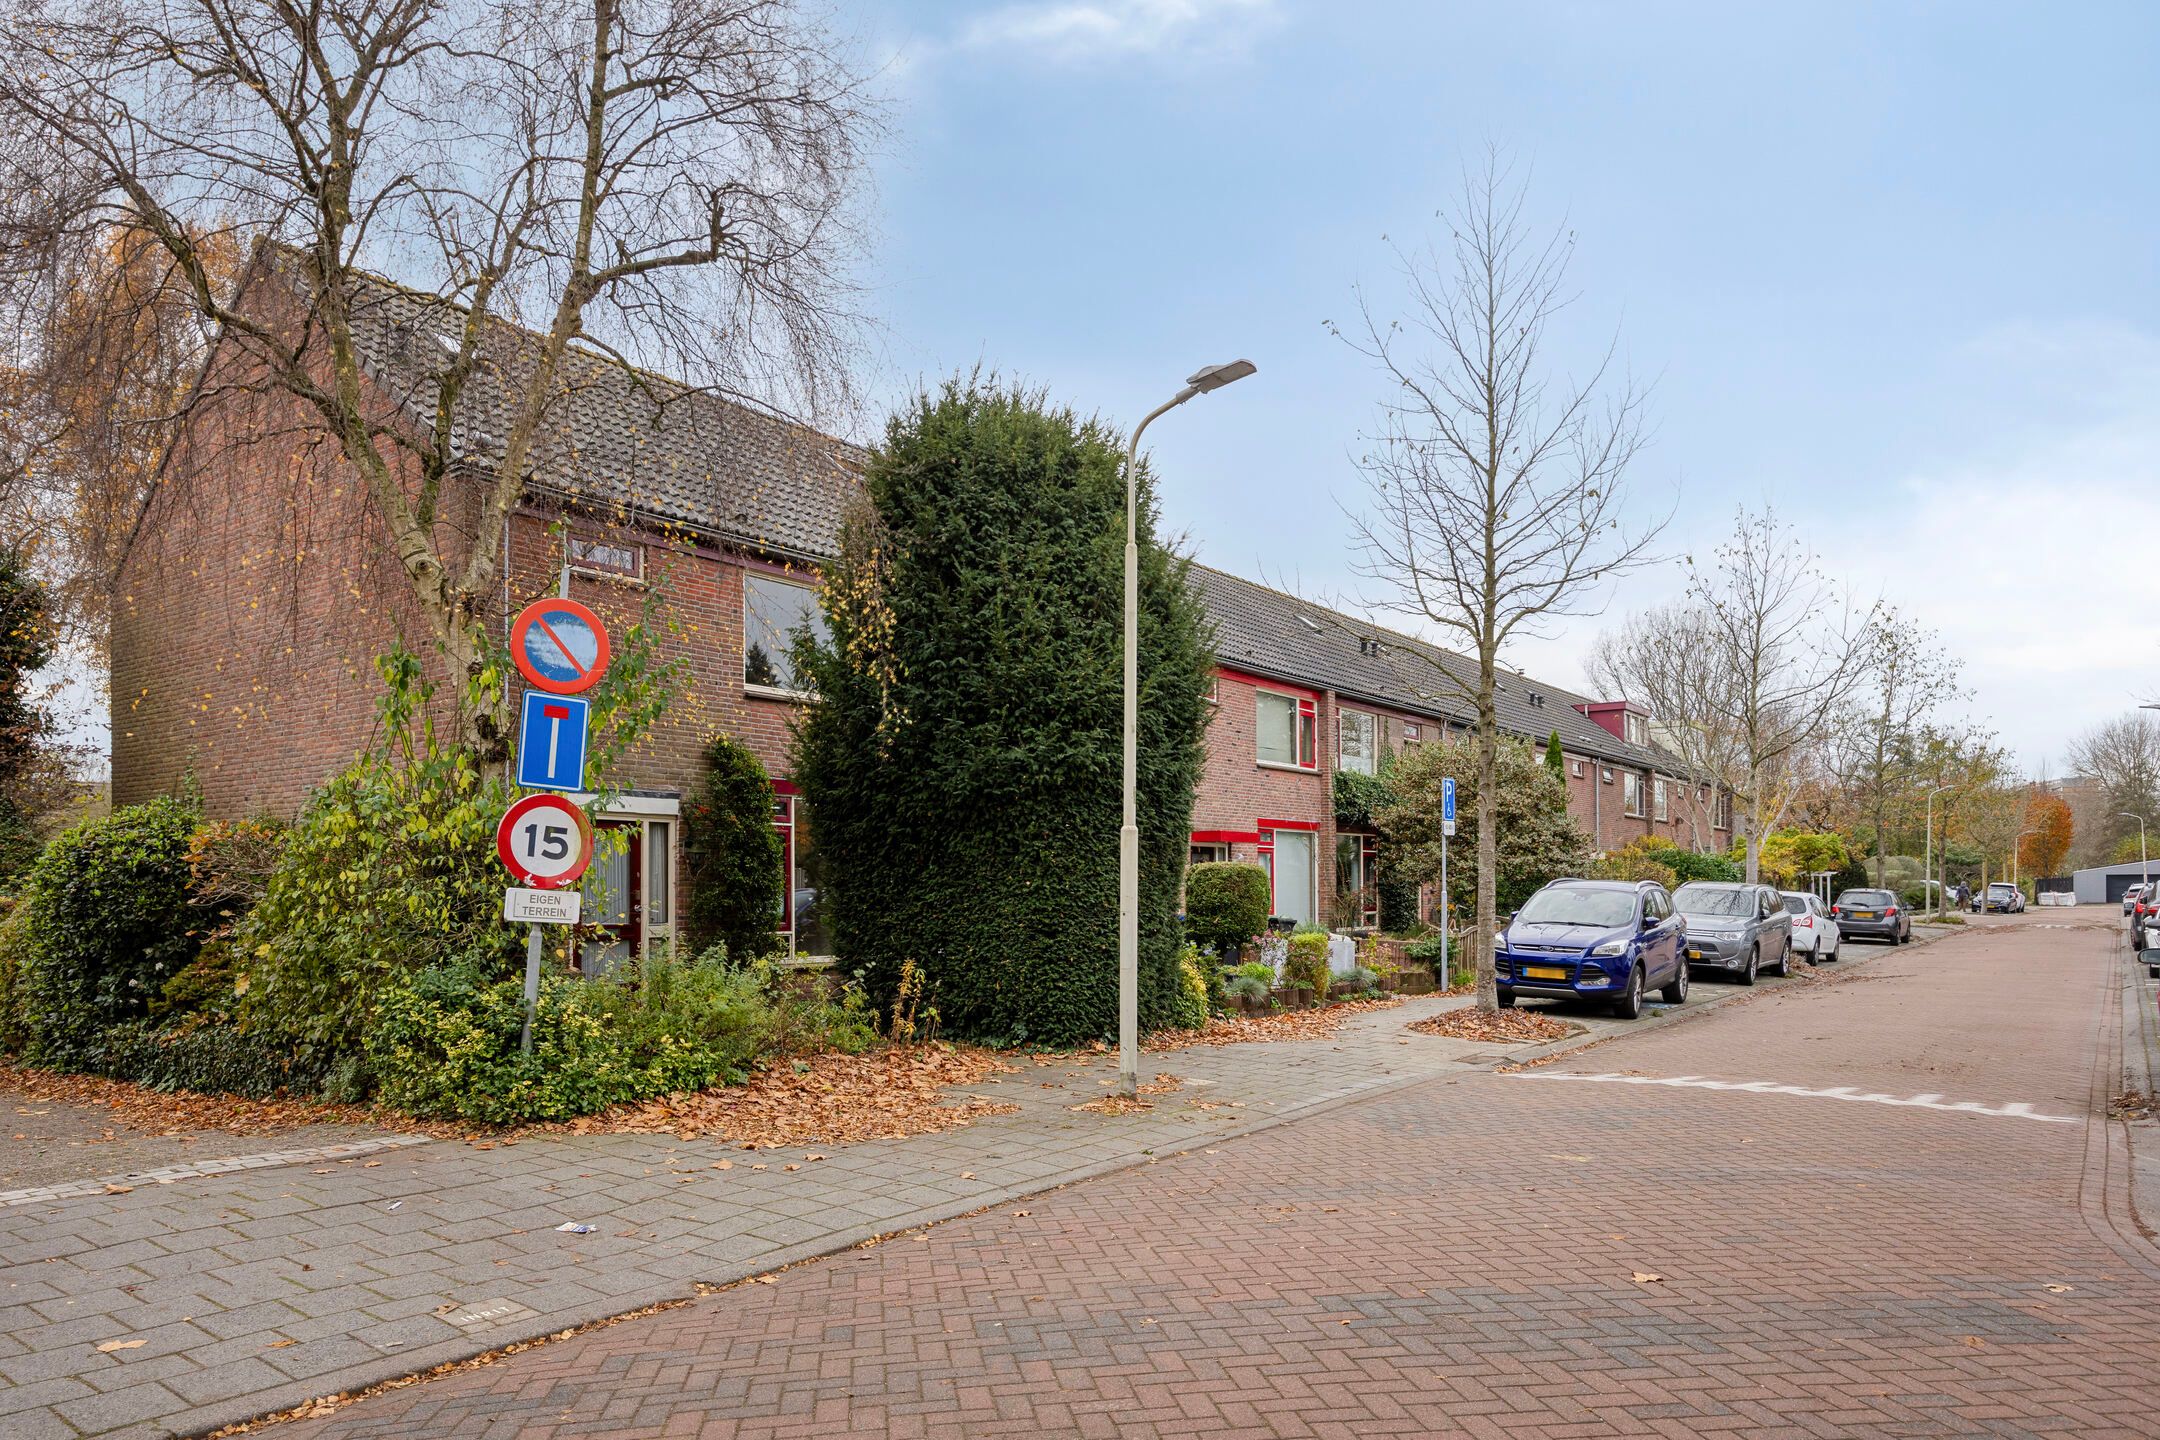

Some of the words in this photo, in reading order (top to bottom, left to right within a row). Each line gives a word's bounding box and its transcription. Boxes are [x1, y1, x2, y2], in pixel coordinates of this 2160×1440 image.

[1446, 783, 1453, 802] P
[525, 824, 569, 860] 15
[529, 894, 561, 905] EIGEN
[522, 906, 567, 917] TERREIN
[460, 1306, 510, 1322] INRIT
